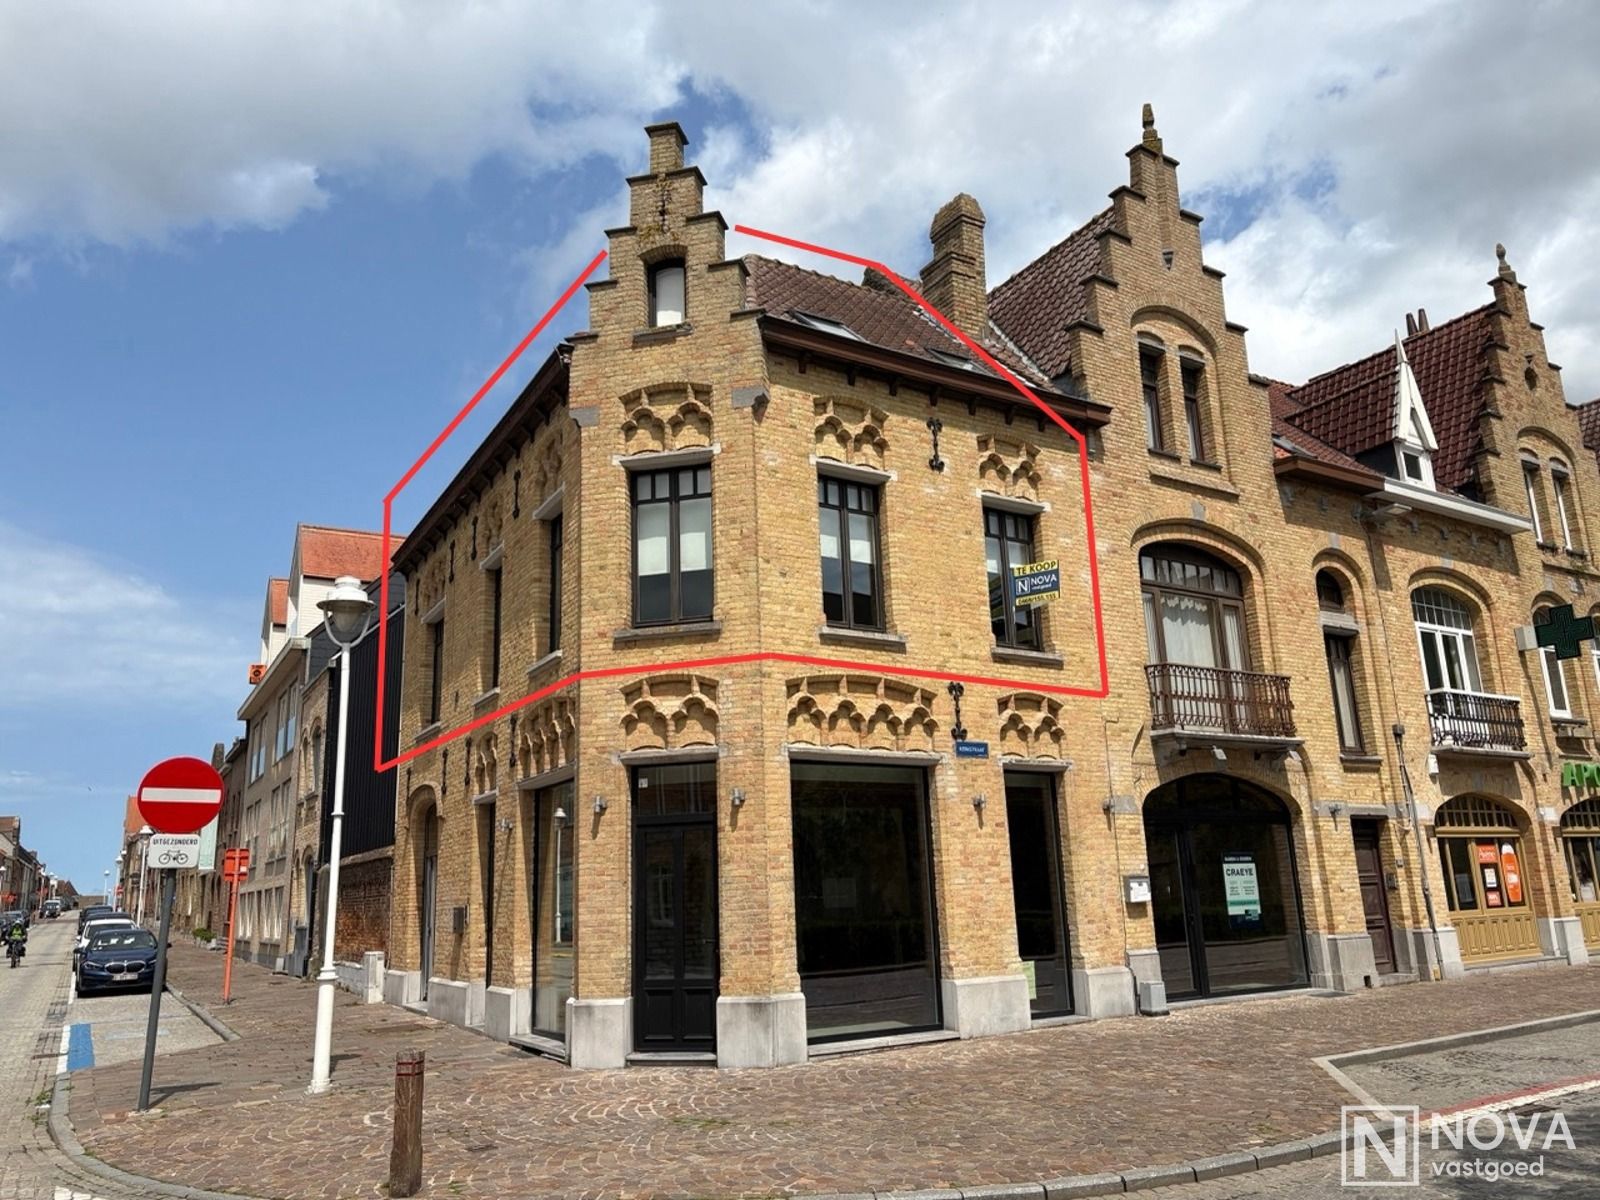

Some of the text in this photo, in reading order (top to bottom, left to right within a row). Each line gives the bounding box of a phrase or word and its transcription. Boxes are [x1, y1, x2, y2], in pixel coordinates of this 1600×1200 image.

[1016, 560, 1056, 575] TE KOOP
[1031, 574, 1057, 585] NOVA
[1018, 579, 1028, 592] N
[153, 838, 198, 846] UITGEZONDERD
[1226, 867, 1254, 877] CRAEYE
